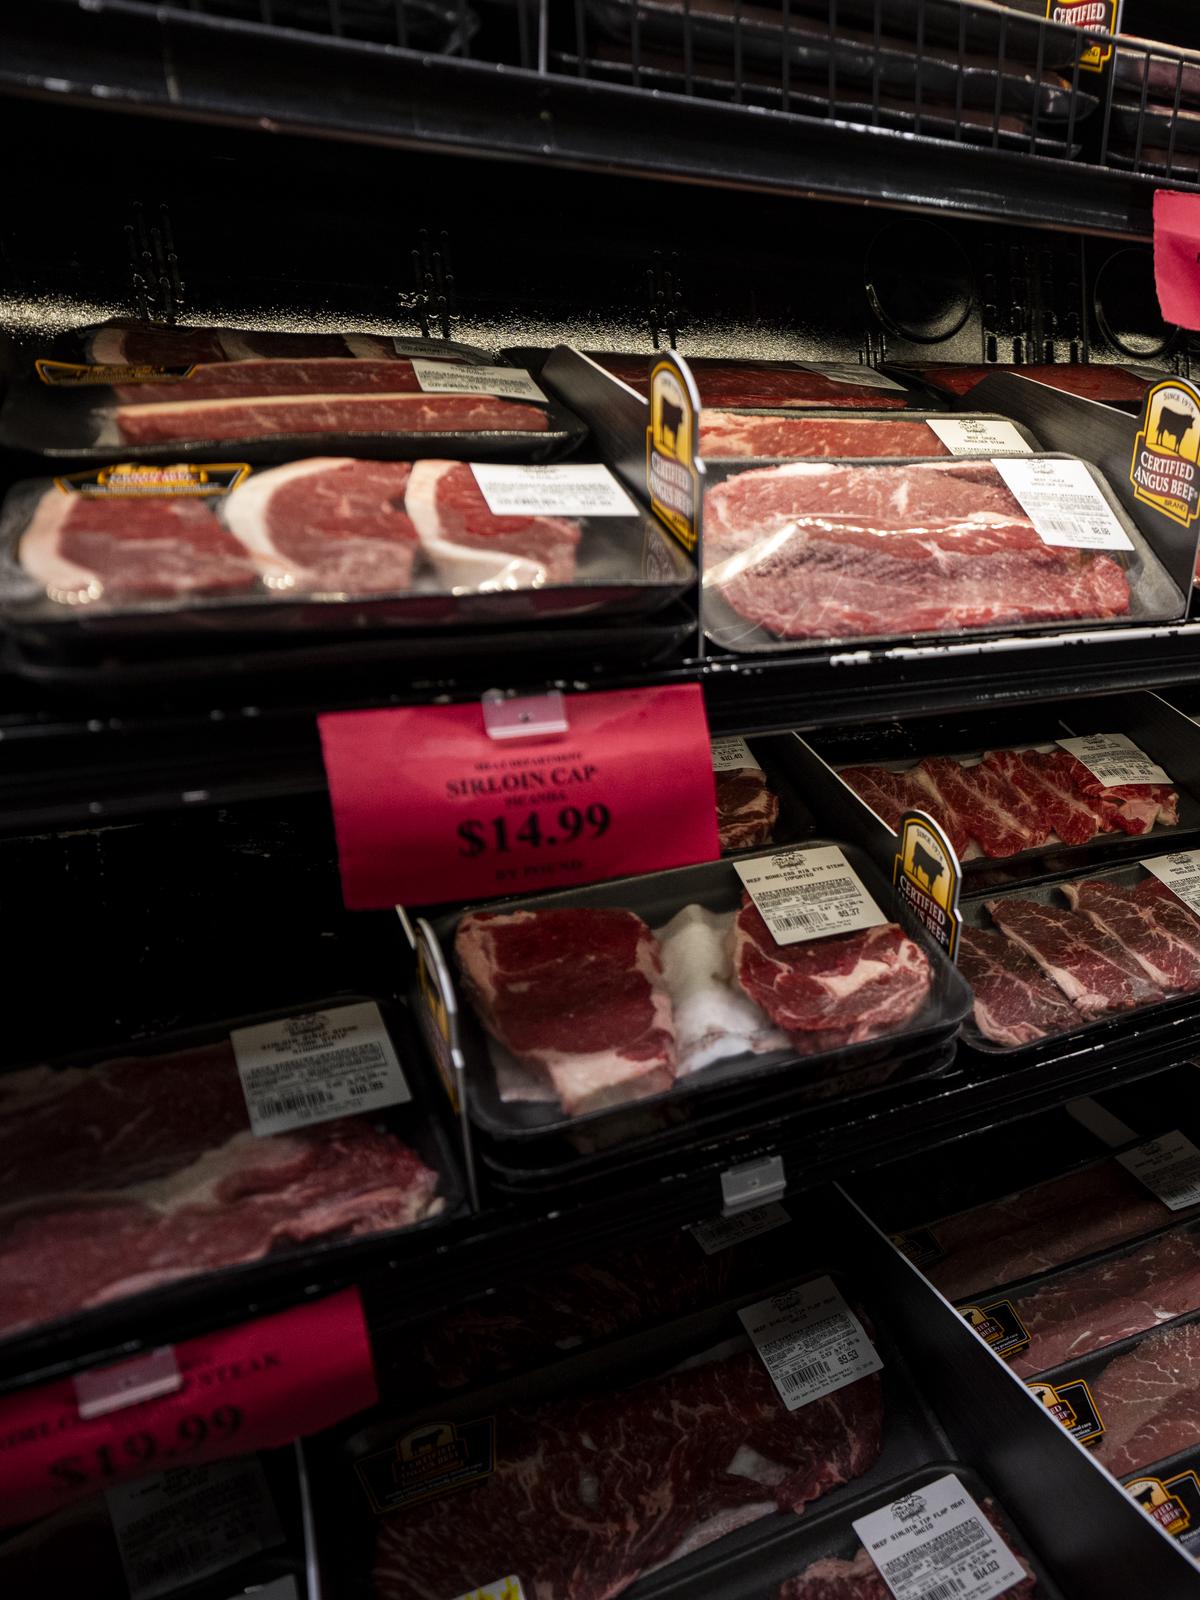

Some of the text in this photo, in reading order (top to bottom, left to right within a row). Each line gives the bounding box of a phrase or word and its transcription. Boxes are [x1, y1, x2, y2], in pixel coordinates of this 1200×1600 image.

[1053, 3, 1106, 25] CERTIFIED
[1134, 465, 1169, 491] ANGUS
[1141, 451, 1195, 481] CERTIFIED
[1164, 498, 1187, 512] BRAND
[446, 764, 596, 800] SIRLOIN CAP
[457, 803, 611, 858] $14.99
[764, 871, 795, 880] BONELESS
[784, 872, 814, 881] IMPORTED
[899, 874, 946, 926] CERTIFIED
[837, 1349, 859, 1365] $9.53
[871, 1498, 966, 1550] BEEF SIRLOIN TIP FLAP MEAT
